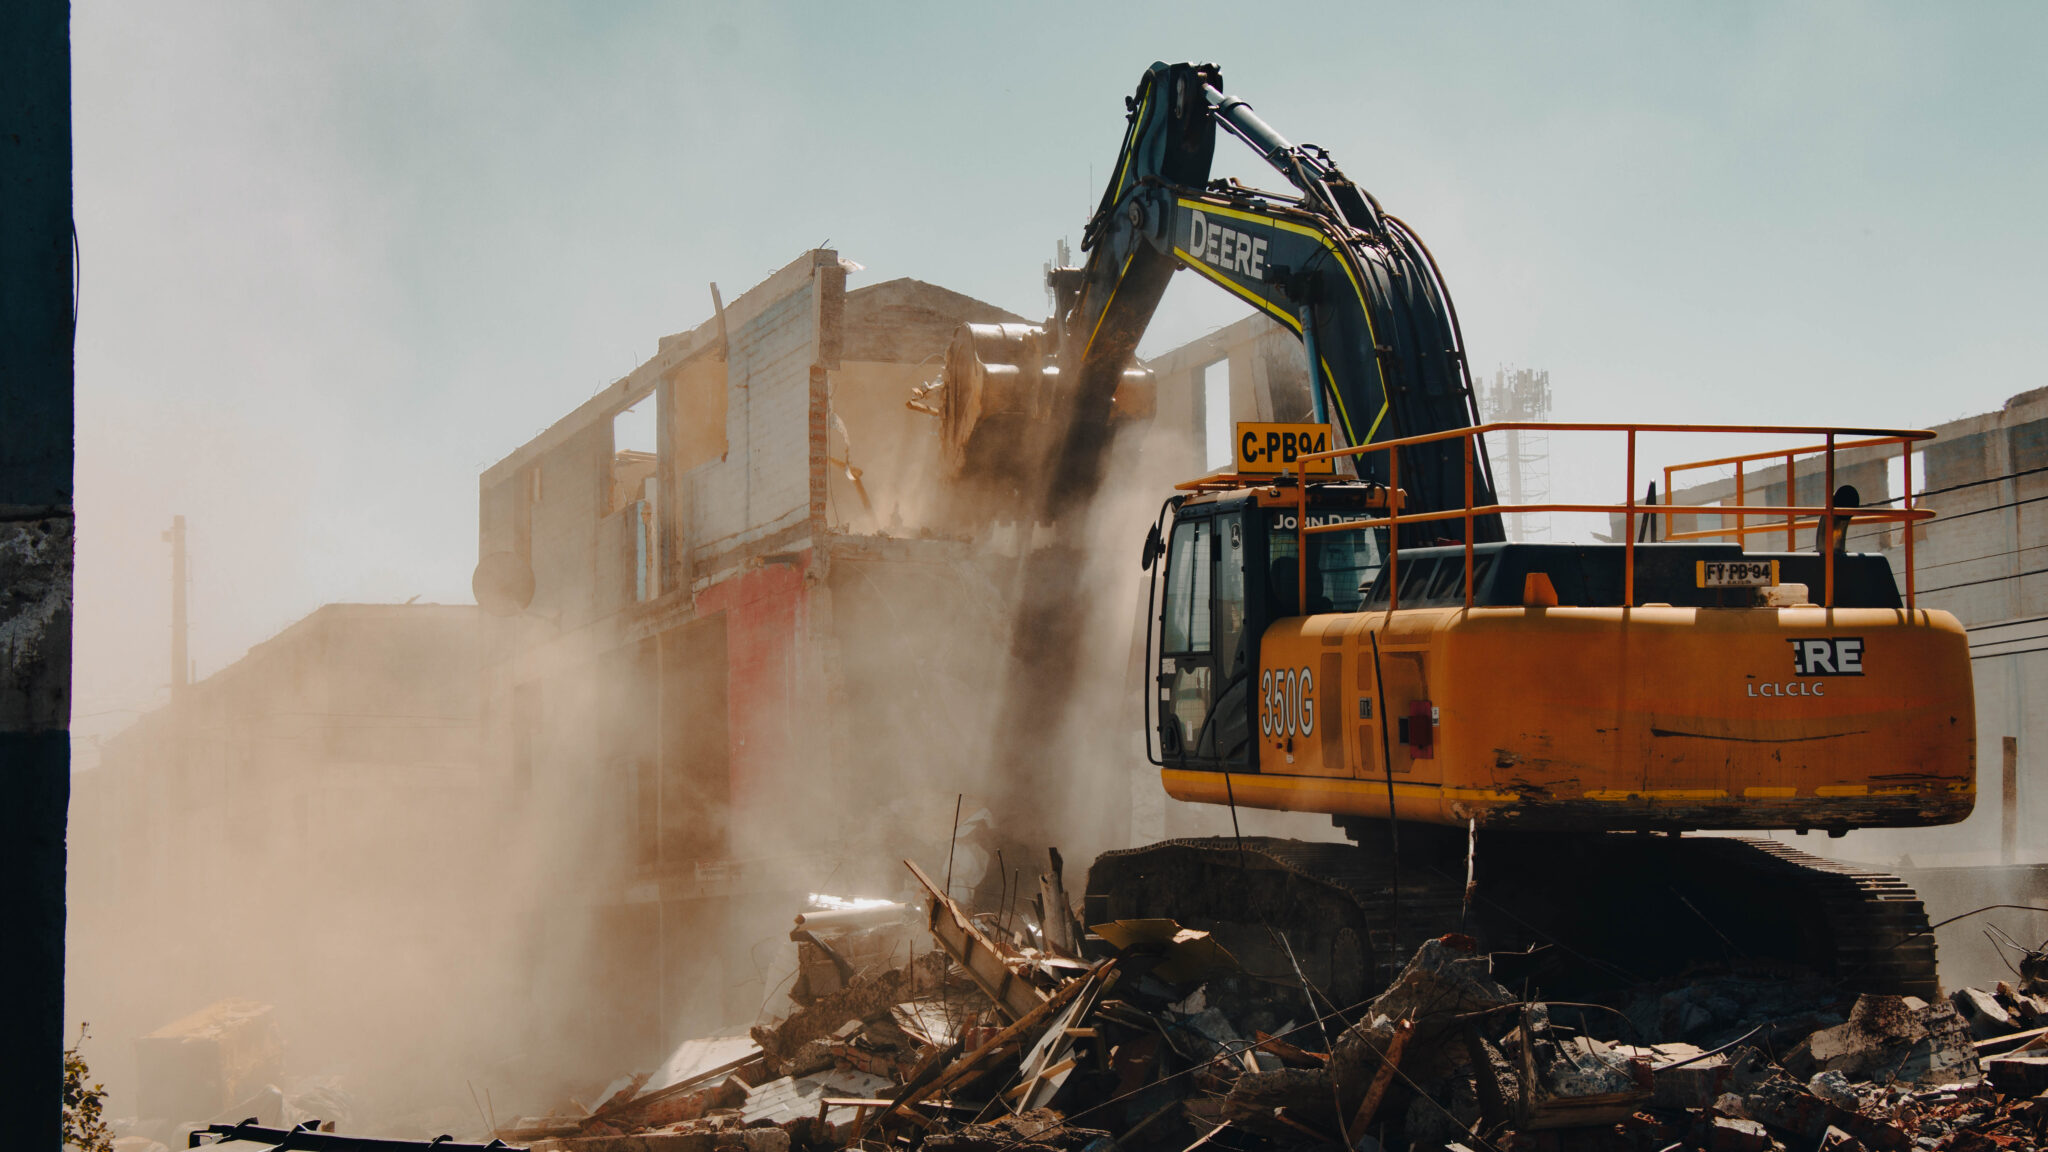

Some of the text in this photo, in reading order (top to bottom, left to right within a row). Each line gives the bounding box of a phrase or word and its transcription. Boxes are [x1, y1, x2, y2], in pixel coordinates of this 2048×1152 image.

[1190, 209, 1268, 280] DEERE
[1241, 431, 1326, 464] C-PB94
[1262, 667, 1313, 737] 350G
[1747, 682, 1824, 697] LCLCLC
